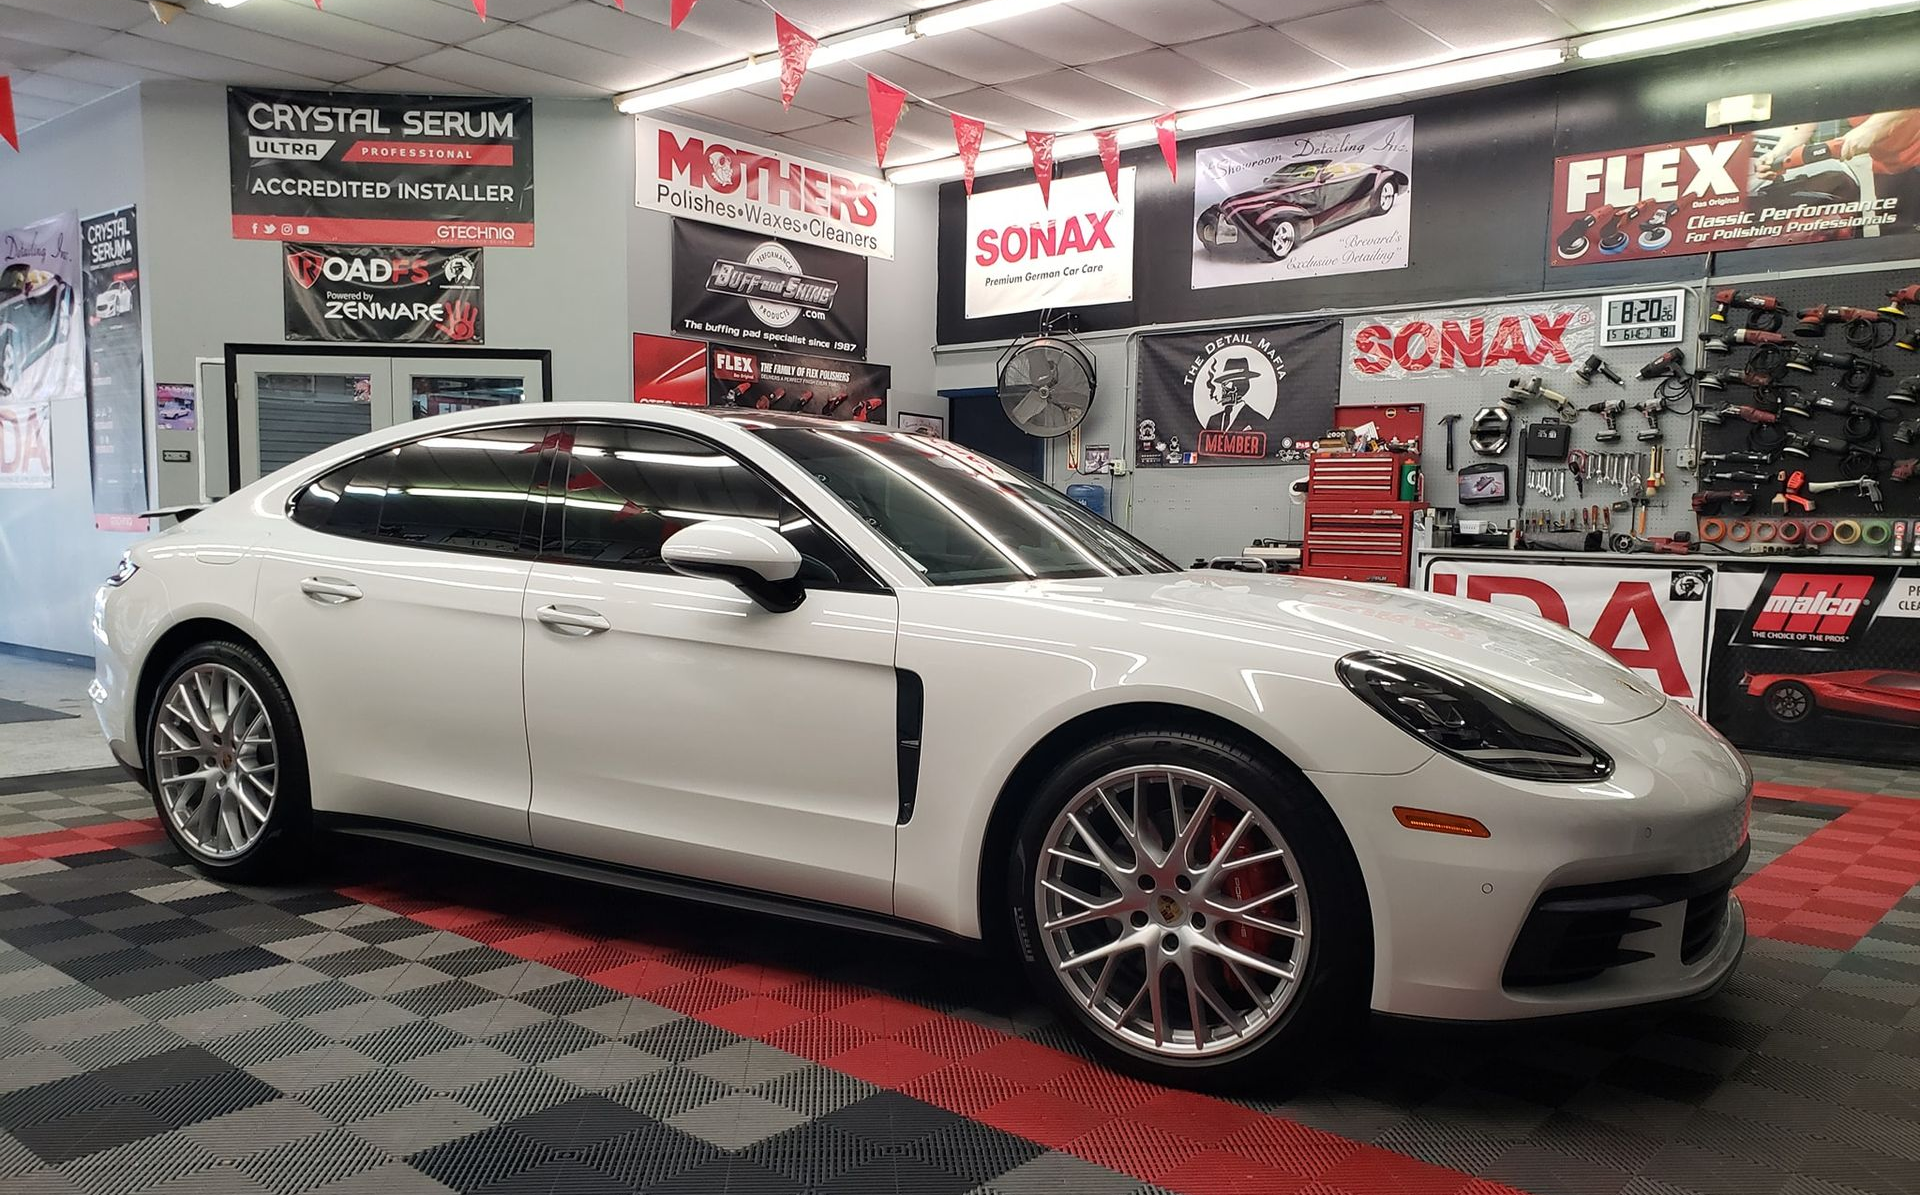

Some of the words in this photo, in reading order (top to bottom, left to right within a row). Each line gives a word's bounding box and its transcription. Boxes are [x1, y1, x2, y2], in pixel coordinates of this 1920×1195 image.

[248, 103, 390, 134] CRYSTAL
[403, 111, 513, 138] SERUM
[256, 140, 317, 156] ULTRA
[361, 147, 472, 159] PROFESSIONAL
[1292, 134, 1365, 159] Detailing
[1373, 131, 1409, 153] Inc.
[658, 129, 877, 227] MOTHERS
[1566, 139, 1745, 213] FLEX
[251, 177, 391, 199] ACCREDITED
[399, 182, 513, 202] INSTALLER
[1687, 209, 1755, 230] Classic
[1759, 197, 1898, 224] Performance
[1692, 201, 1707, 209] Das
[1708, 196, 1739, 207] Original
[657, 184, 737, 219] Polishes
[745, 203, 801, 231] Waxes
[809, 219, 878, 250] Cleaners
[1685, 230, 1711, 243] For
[1713, 222, 1781, 241] Polishing
[1786, 213, 1897, 234] Professionals
[88, 217, 130, 244] CRYSTAL
[437, 225, 515, 240] GTECHNIQ
[975, 209, 1115, 266] SONAX
[92, 239, 126, 263] SERUM
[756, 252, 793, 271] PERFORMANCE
[1286, 256, 1339, 270] Exclusive
[984, 274, 1023, 287] Premium
[1025, 270, 1060, 282] German
[1063, 267, 1080, 276] Car
[1081, 263, 1103, 274] Care
[327, 291, 362, 301] Powered
[363, 292, 373, 302] by
[324, 302, 444, 321] ZENWARE
[759, 304, 790, 320] PRODUCTS
[802, 309, 826, 321] .com
[1621, 299, 1662, 324] 8:20
[684, 319, 703, 331] The
[705, 323, 740, 337] buffing
[743, 328, 761, 341] pad
[763, 331, 806, 346] specialist
[808, 339, 830, 349] since
[834, 342, 857, 352] 1987
[1353, 311, 1577, 374] SONAX
[717, 353, 753, 373] FLEX
[1184, 356, 1204, 386] THE
[1205, 333, 1253, 355] DETAIL
[1257, 337, 1287, 381] MAFIA
[760, 362, 773, 374] THE
[773, 364, 796, 376] FAMILY
[798, 366, 807, 377] OF
[806, 367, 819, 379] FLEX
[820, 369, 851, 383] POLISHERS
[1205, 433, 1260, 455] MEMBER
[1762, 591, 1862, 616] malco
[1767, 632, 1795, 640] CHOICE
[1808, 634, 1824, 642] THE
